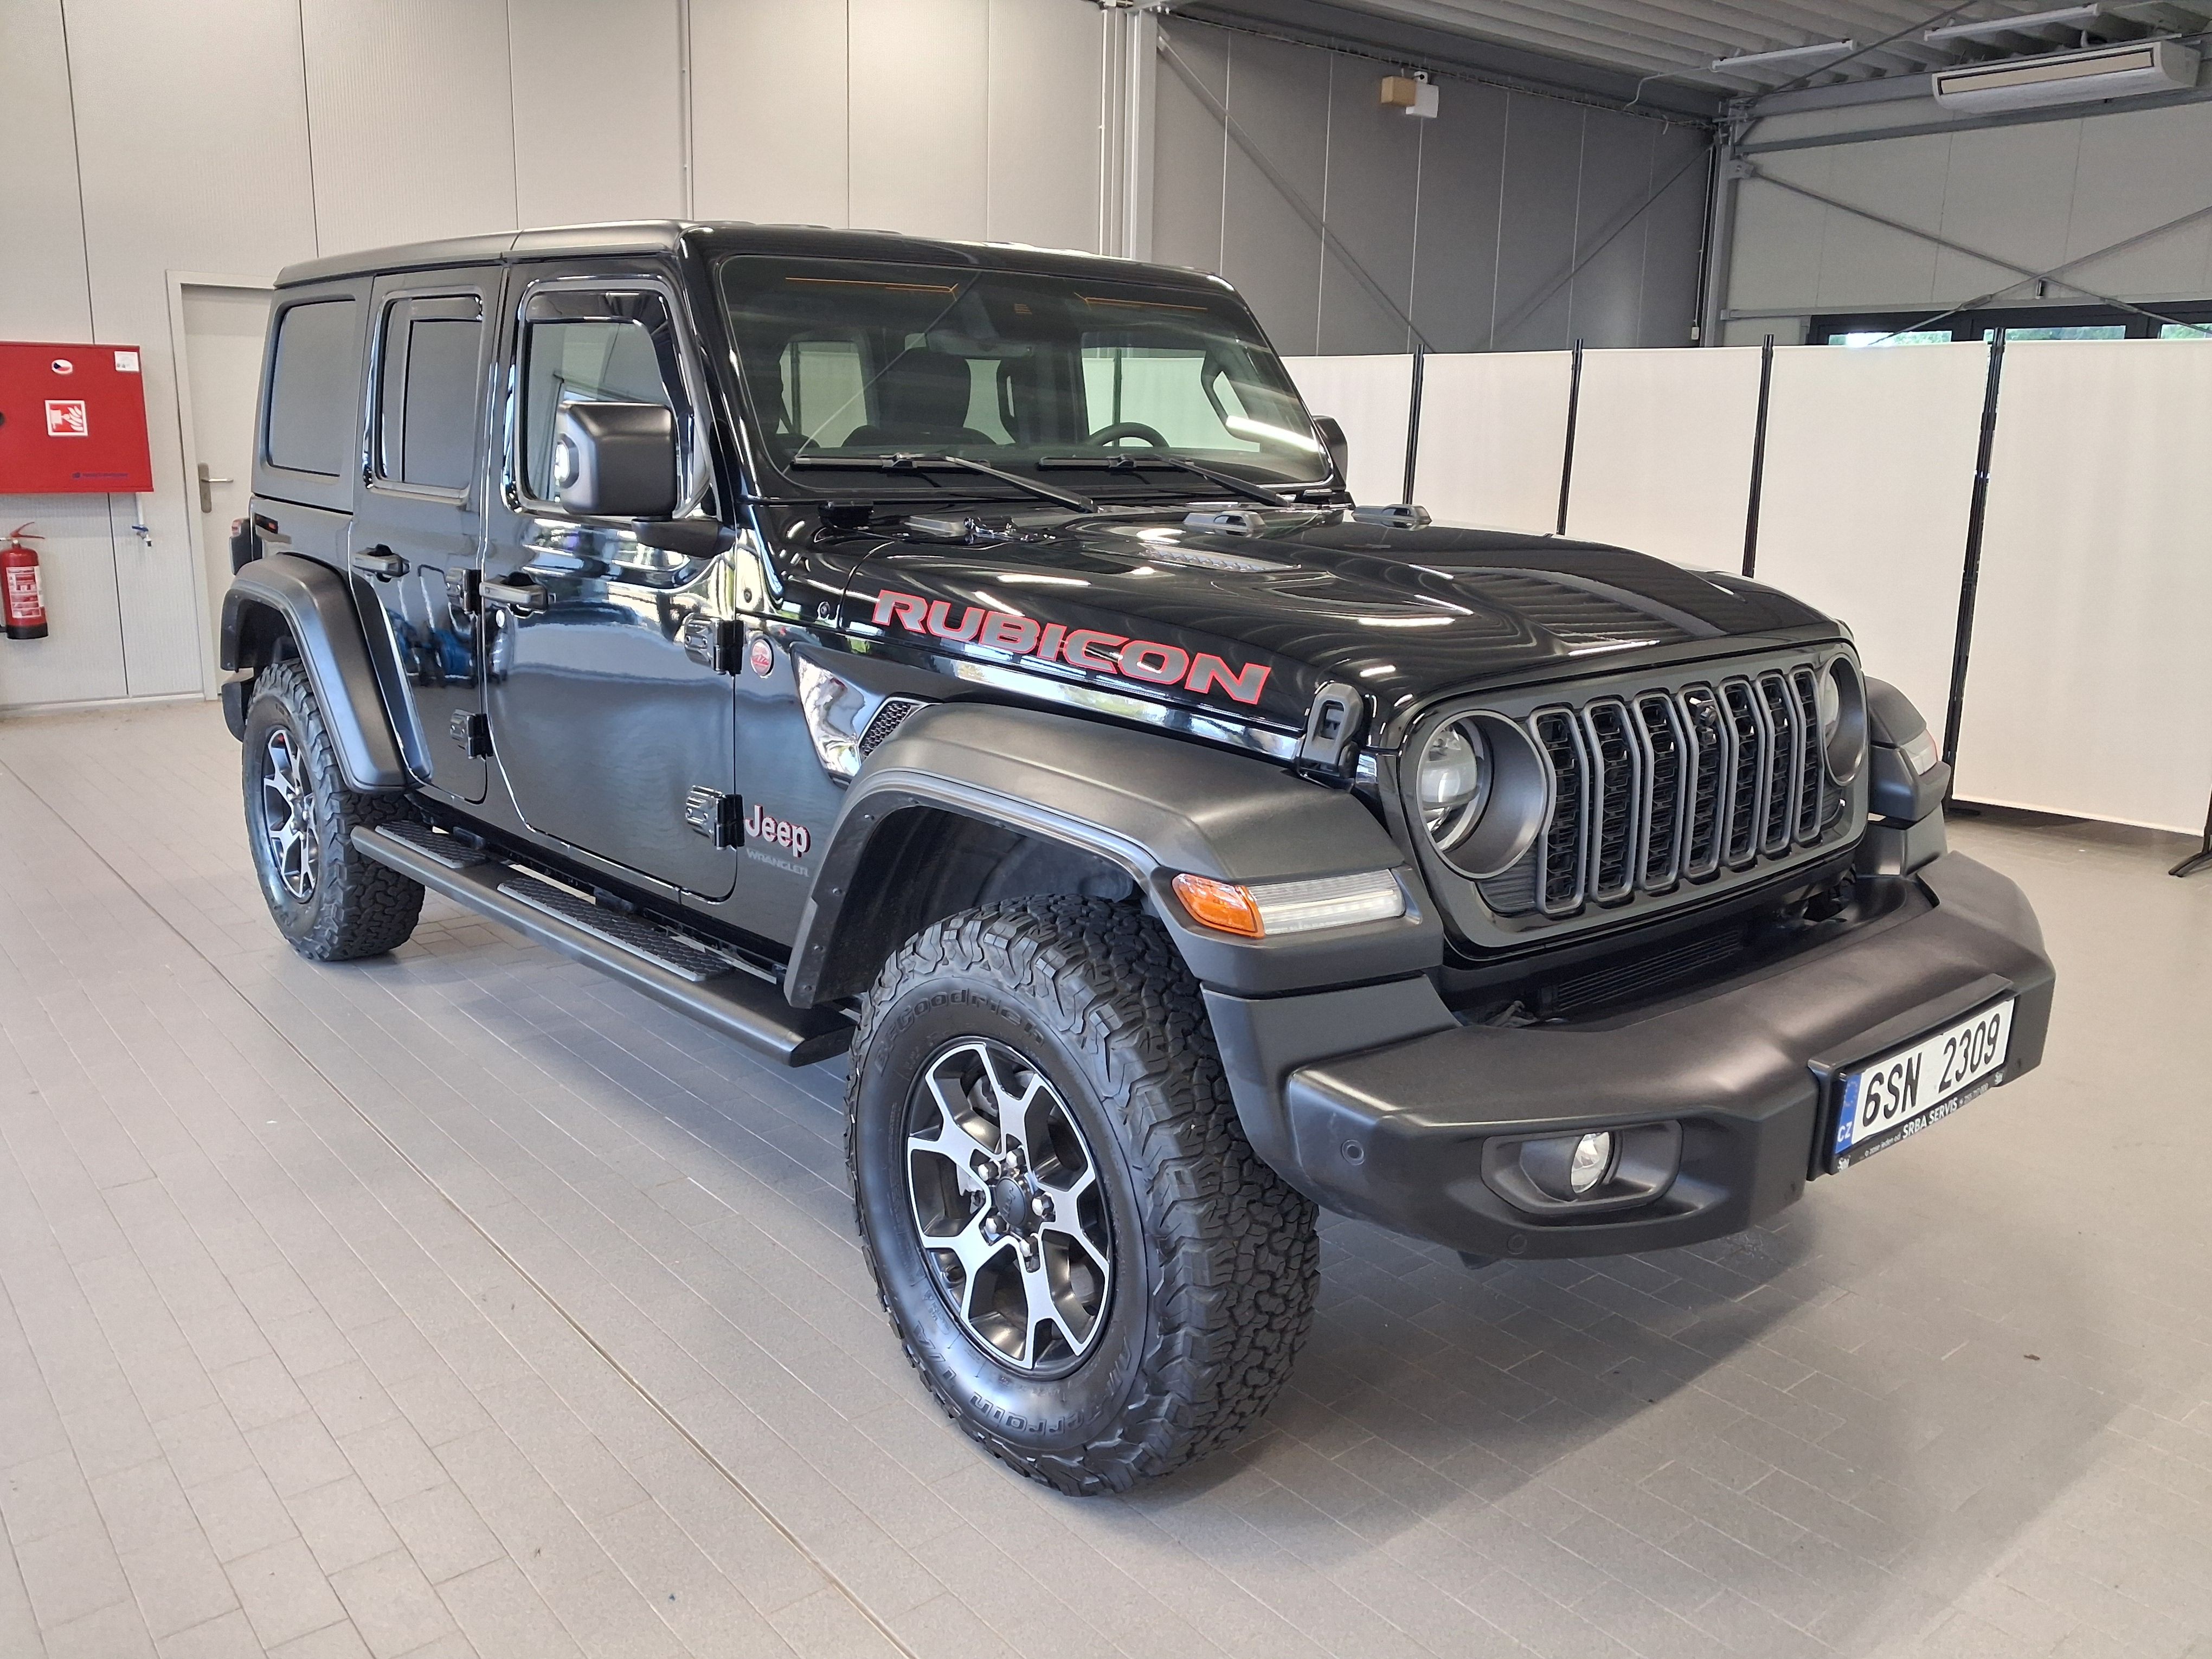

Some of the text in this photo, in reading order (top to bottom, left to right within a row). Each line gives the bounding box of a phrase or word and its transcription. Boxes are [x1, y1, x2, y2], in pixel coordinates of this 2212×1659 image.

[872, 589, 1271, 705] RUBICON
[744, 805, 811, 858] Jeep
[746, 847, 809, 877] WRANGLER
[1862, 1013, 2001, 1127] 6SN 2309
[1837, 1121, 1853, 1143] CZ
[1902, 1097, 1958, 1139] SRBA SERVIS
